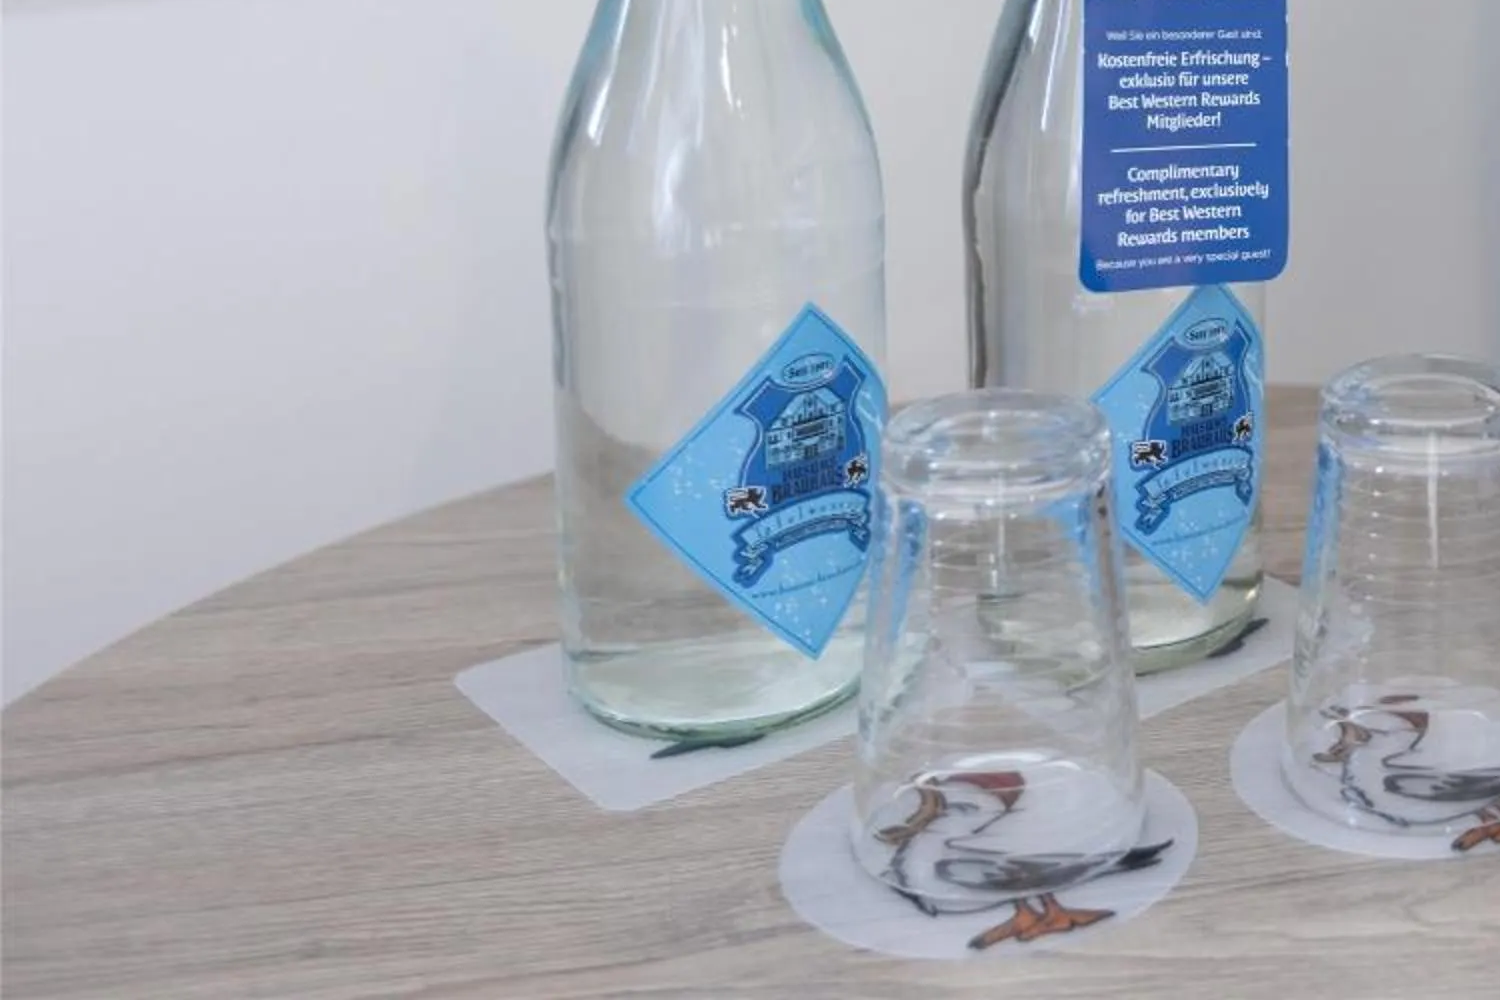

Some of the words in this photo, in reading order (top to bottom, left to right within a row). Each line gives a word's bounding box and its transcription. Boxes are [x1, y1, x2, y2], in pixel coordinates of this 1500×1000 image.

[1098, 51, 1177, 68] Kostenfreie
[1181, 49, 1260, 69] Erfrischung
[1119, 73, 1175, 89] exklusiv
[1179, 71, 1199, 87] für
[1202, 73, 1249, 86] unsere
[1108, 96, 1139, 110] Best
[1141, 94, 1198, 109] Western
[1201, 91, 1261, 107] Rewards
[1147, 112, 1221, 132] Mitglieder!
[1127, 164, 1239, 183] Complimentary
[1098, 188, 1189, 205] refreshment,
[1190, 181, 1270, 199] exclusively
[1125, 210, 1146, 224] for
[1150, 207, 1180, 221] Best
[1182, 204, 1242, 220] Western
[1117, 229, 1178, 247] Rewards
[1181, 225, 1250, 243] members
